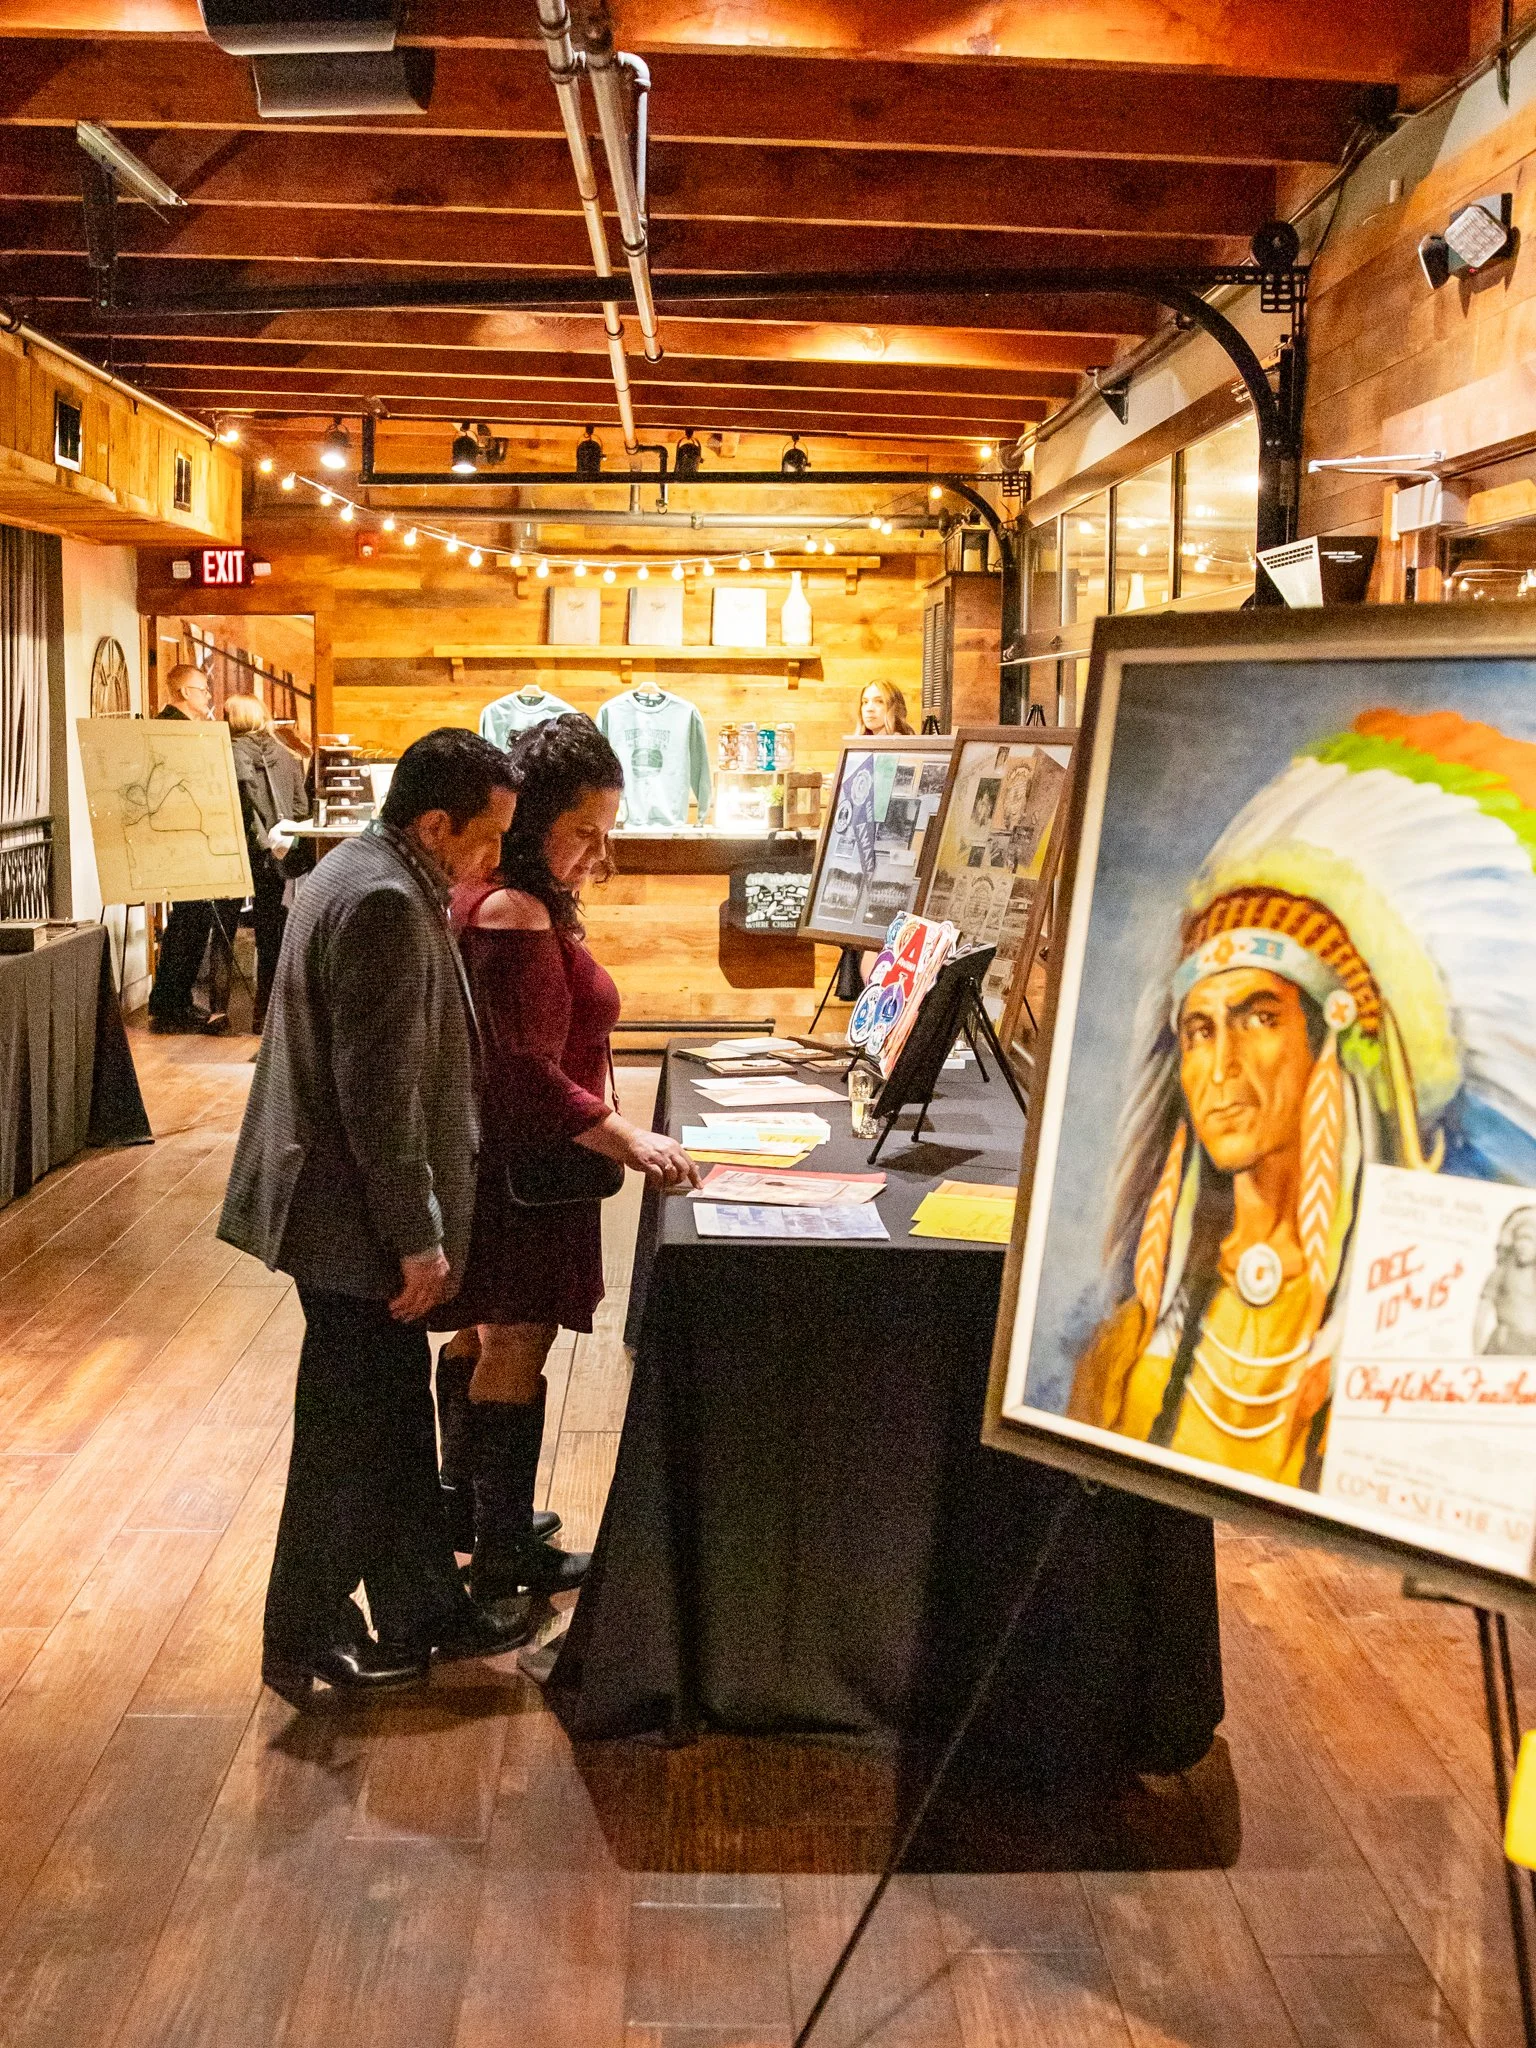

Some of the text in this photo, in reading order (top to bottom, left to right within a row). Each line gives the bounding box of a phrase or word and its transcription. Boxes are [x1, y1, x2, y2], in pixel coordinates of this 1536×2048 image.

[203, 551, 245, 583] EXIT
[856, 822, 873, 881] AWANA
[745, 920, 797, 929] WHERE CHRIST
